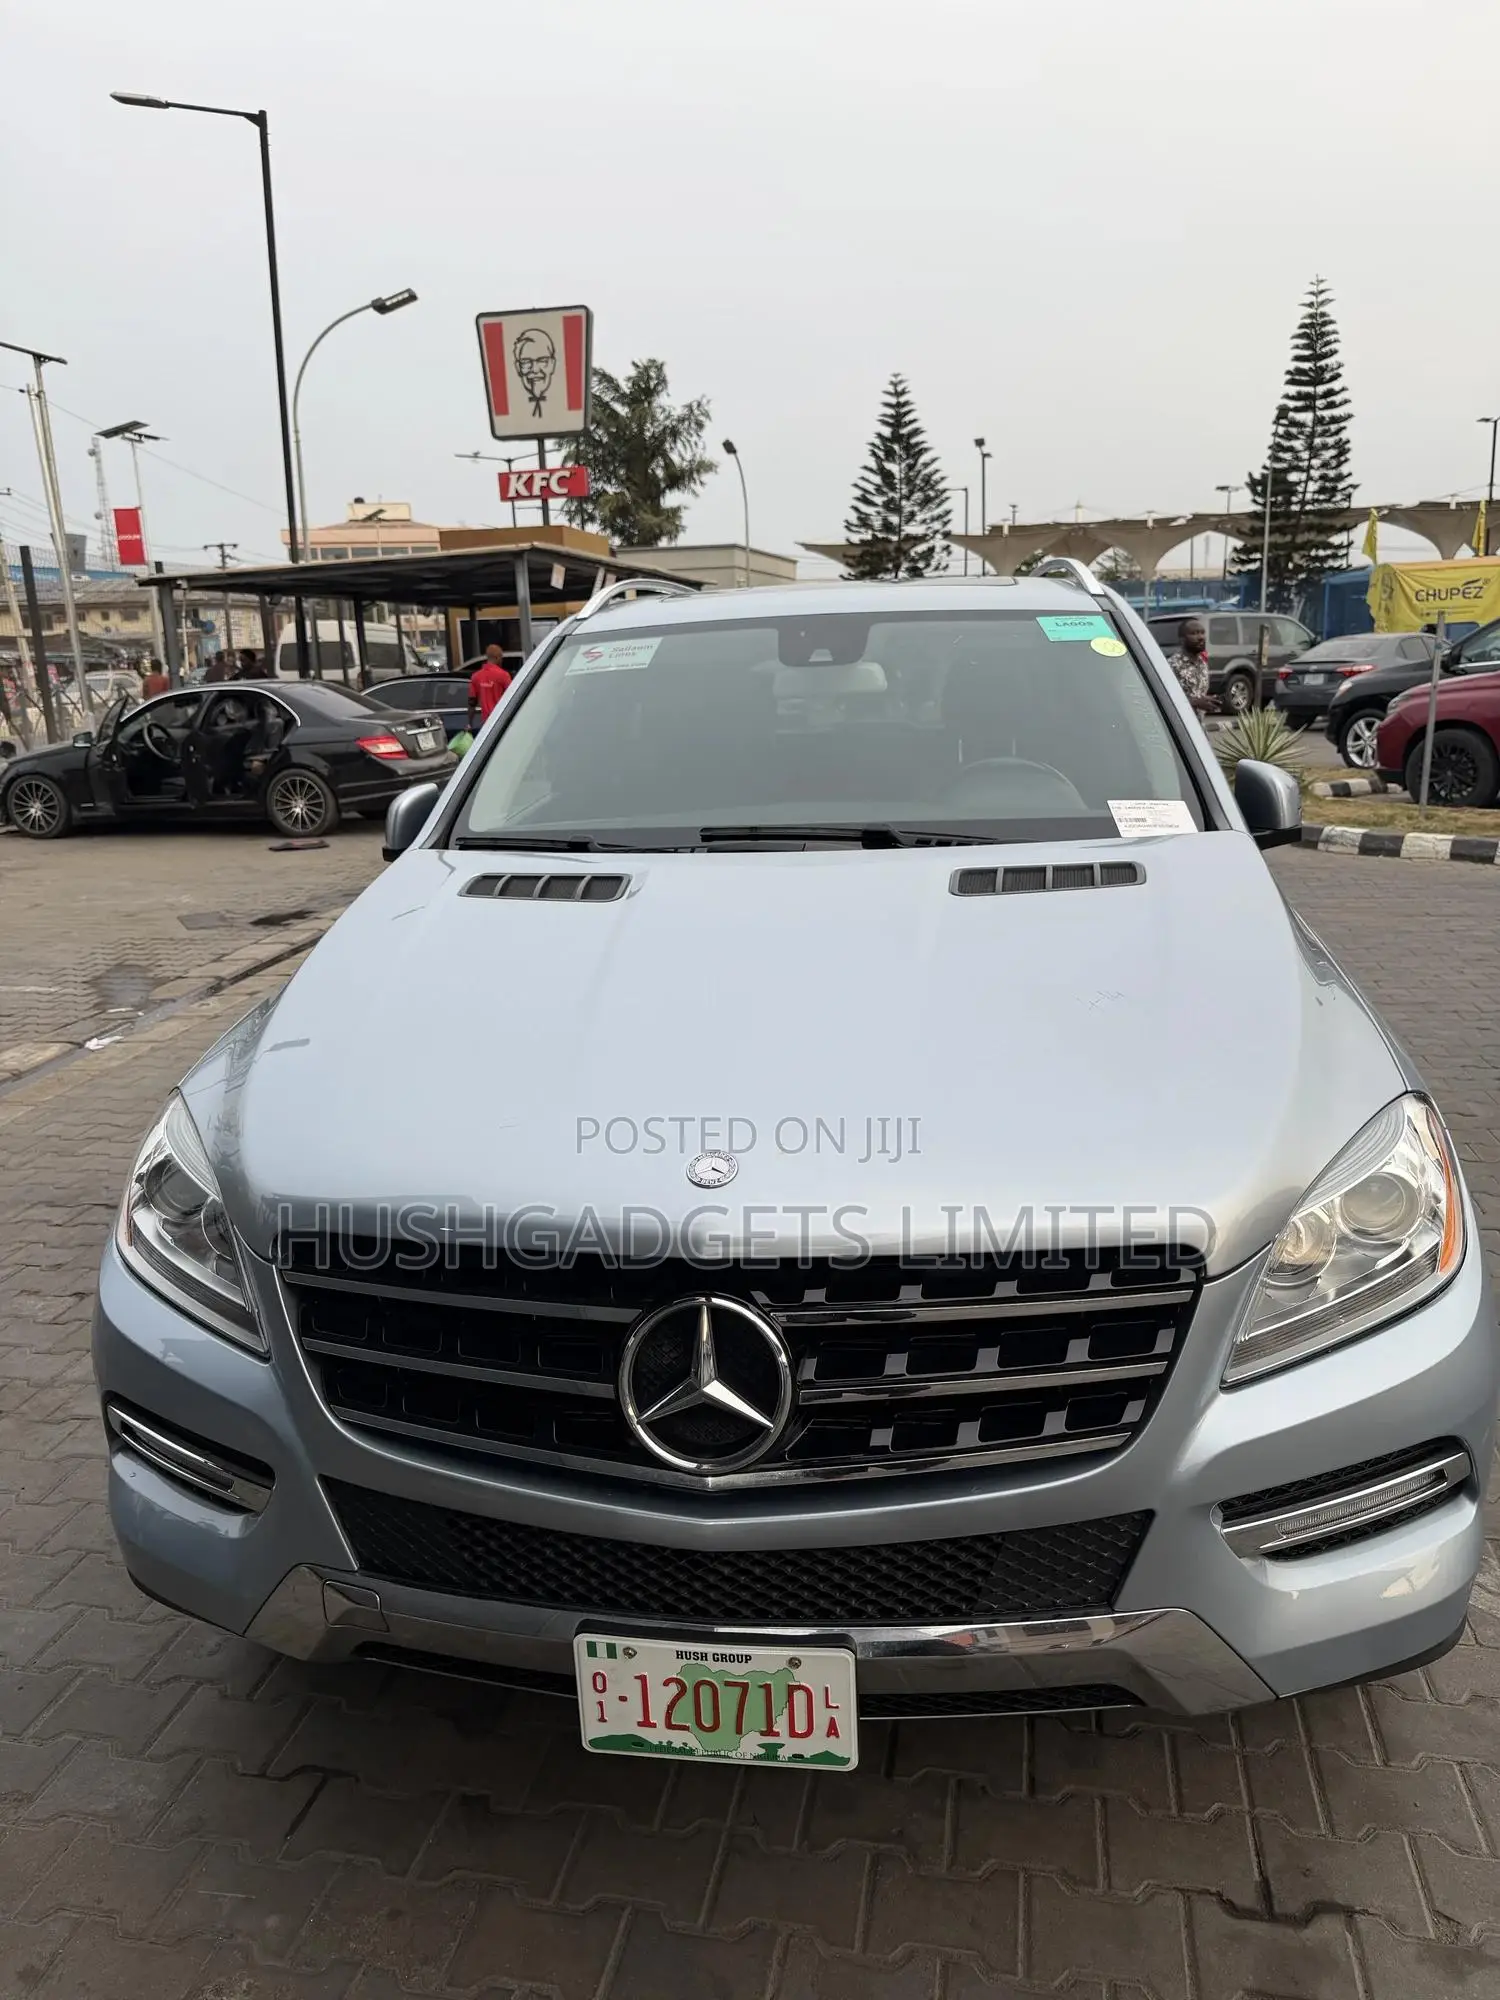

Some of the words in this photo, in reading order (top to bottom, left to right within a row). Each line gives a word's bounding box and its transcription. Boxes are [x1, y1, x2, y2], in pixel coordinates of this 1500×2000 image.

[507, 470, 571, 498] KFC
[676, 1650, 709, 1662] HUSH
[712, 1652, 752, 1664] GROUP
